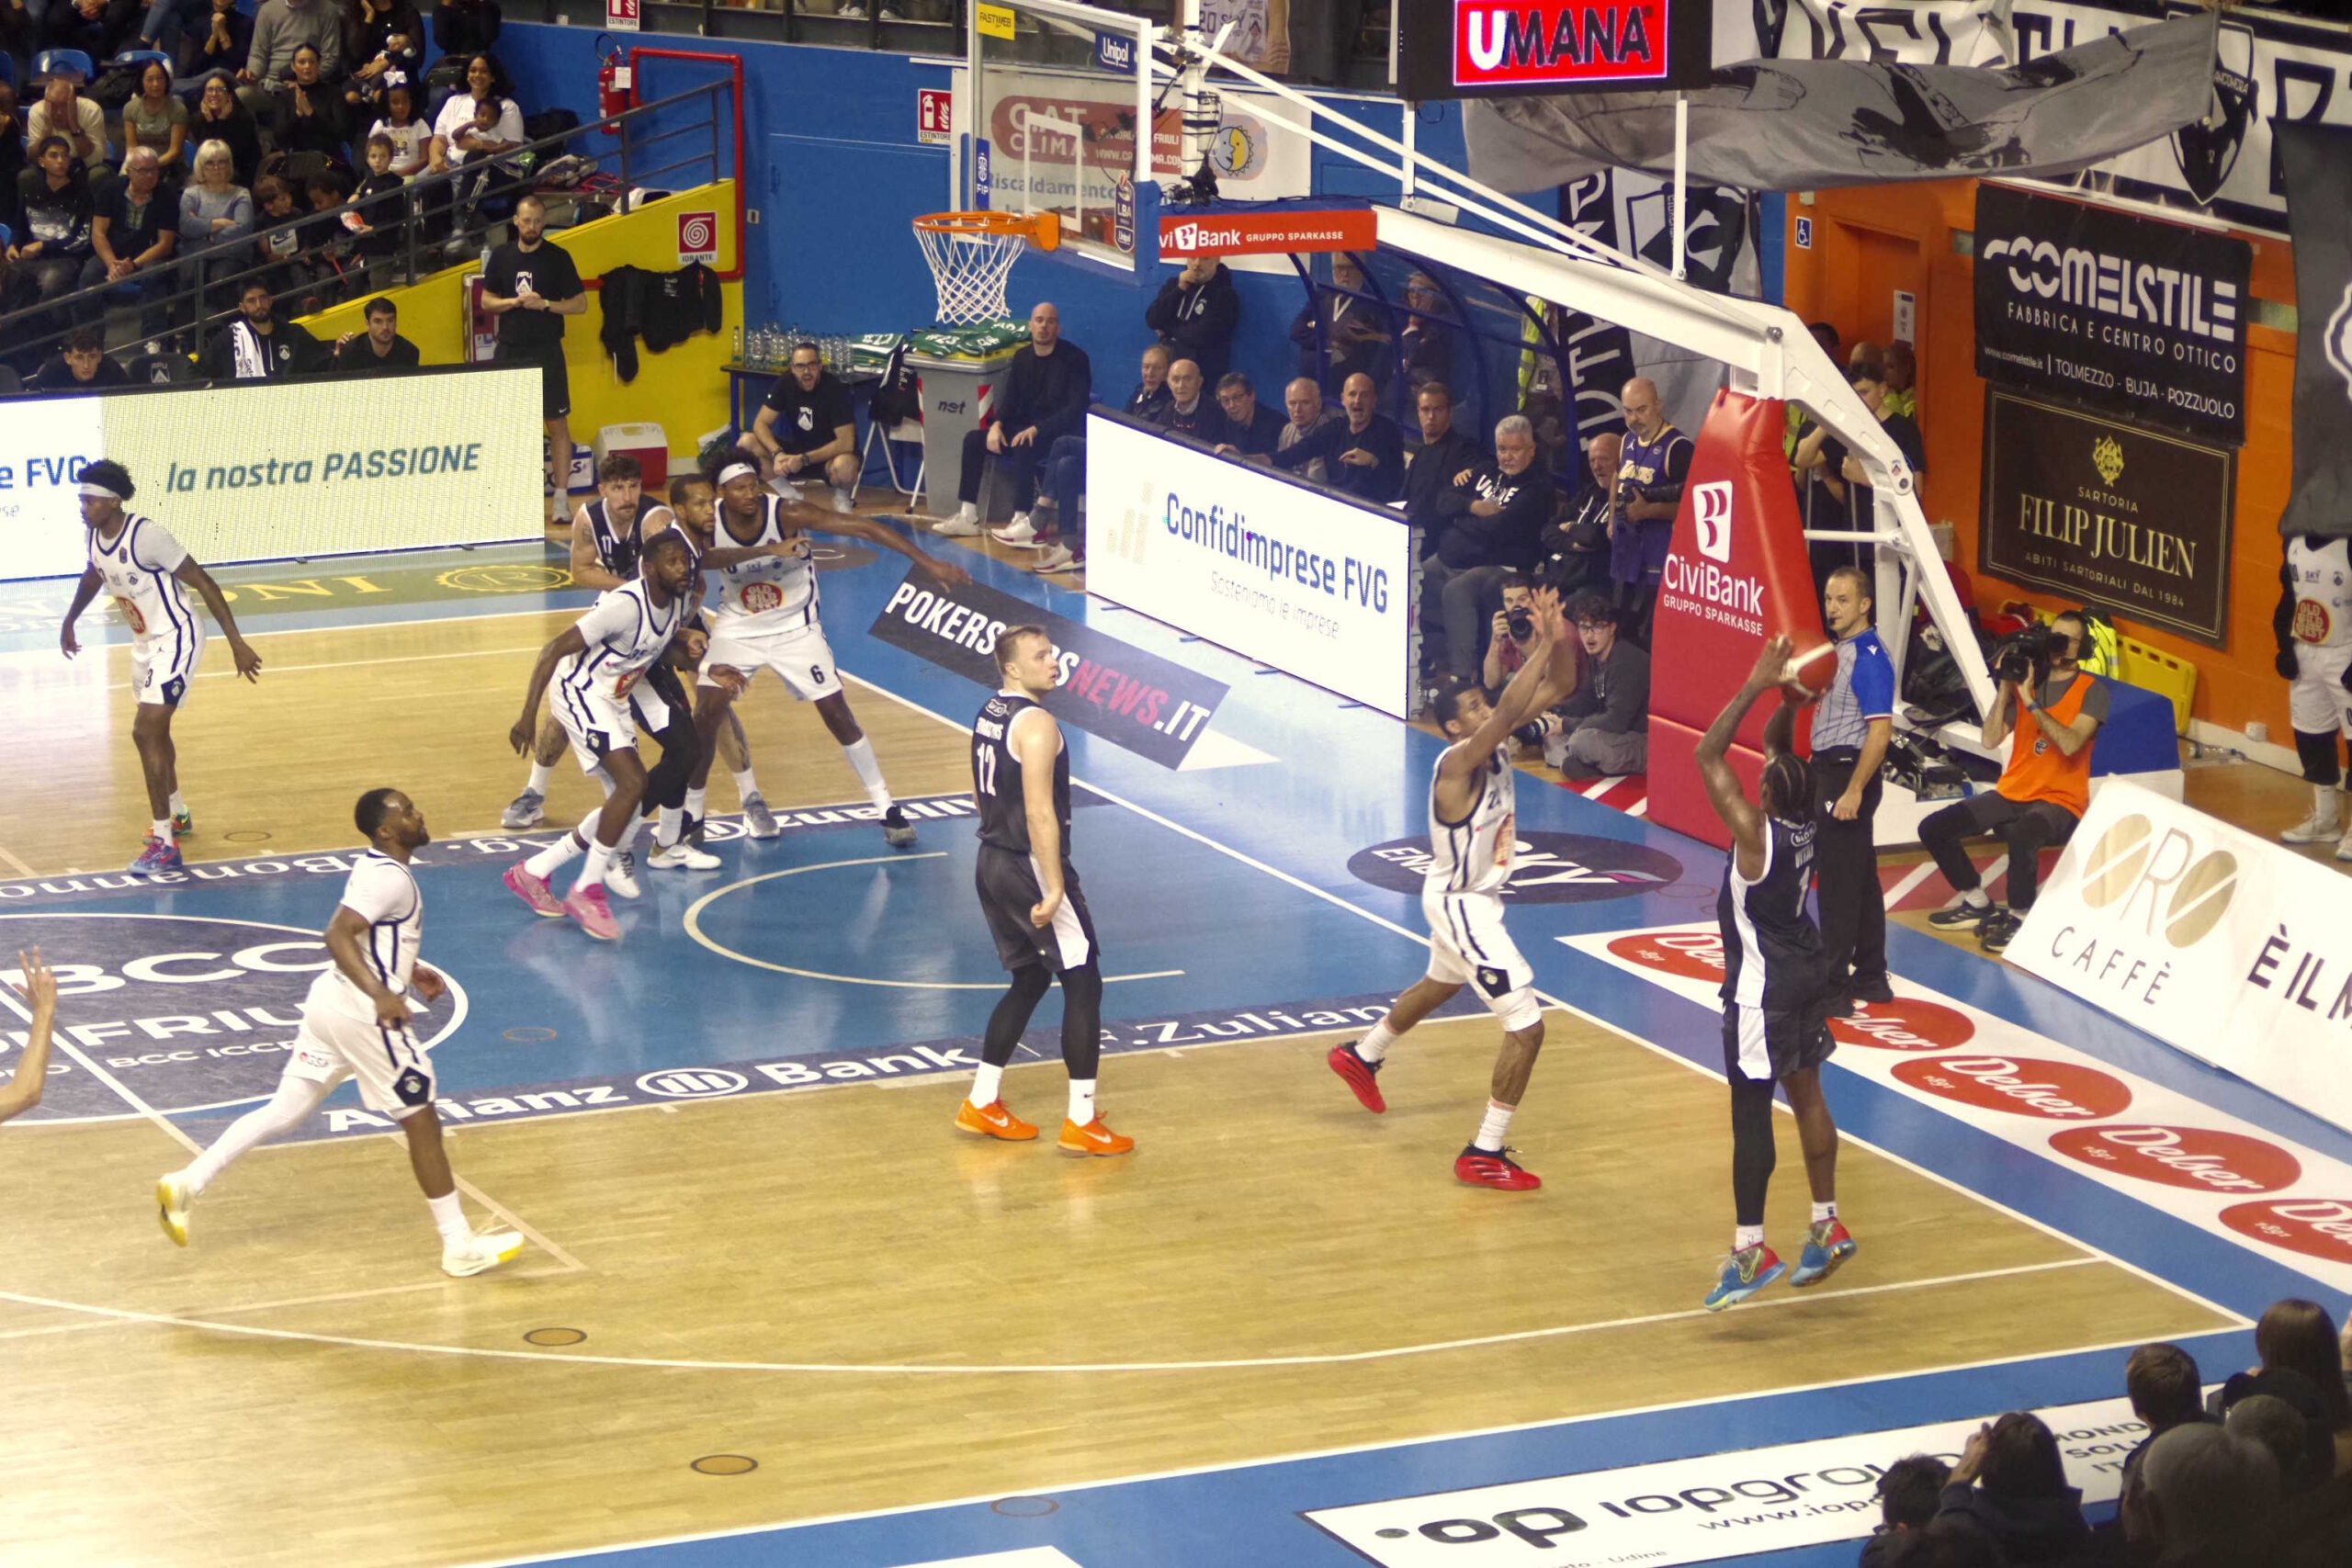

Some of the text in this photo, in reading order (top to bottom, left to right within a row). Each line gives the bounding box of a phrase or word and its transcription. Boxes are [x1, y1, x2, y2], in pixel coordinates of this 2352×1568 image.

[608, 18, 638, 27] ESTINTORE
[979, 12, 1012, 28] FASTWEB
[1469, 6, 1652, 70] UMANA
[1102, 37, 1129, 67] Unipol
[1010, 132, 1088, 158] CLIMA
[1153, 132, 1181, 145] FRIULI
[977, 183, 989, 195] FIP
[1117, 202, 1132, 217] LBA
[682, 254, 714, 263] IDRANTE
[1246, 232, 1284, 243] GRUPPO
[1288, 231, 1343, 241] SPARKASSE
[2007, 301, 2236, 373] FABBRICA E CENTRO OTTICO
[938, 400, 966, 415] net
[2055, 358, 2114, 389] TOLMEZZO
[2125, 378, 2158, 399] BUJA
[2168, 388, 2235, 420] POZZUOLO
[166, 443, 482, 493] la nostra PASSIONE
[2078, 486, 2138, 513] SARTORIA
[1167, 492, 1388, 614] Confidimprese FVG
[2018, 493, 2197, 580] FILIP JULIEN
[1664, 553, 1764, 616] CiviBank
[2025, 552, 2185, 607] ABITI SARTORIALI DAL 1984
[1211, 570, 1340, 640] Sosteniamo le imprese
[1664, 593, 1763, 637] GRUPPO SPARKASSE
[2300, 603, 2321, 615] OLD
[810, 664, 825, 684] 6
[977, 741, 996, 796] 12
[1795, 865, 1810, 918] 1
[0, 942, 335, 996] BCC
[2052, 926, 2171, 1005] CAFFÈ
[2247, 922, 2290, 989] È
[107, 1050, 200, 1069] BCC
[755, 1045, 981, 1086] Bank
[1939, 1057, 2095, 1117] Delser
[2101, 1127, 2265, 1190] Delser
